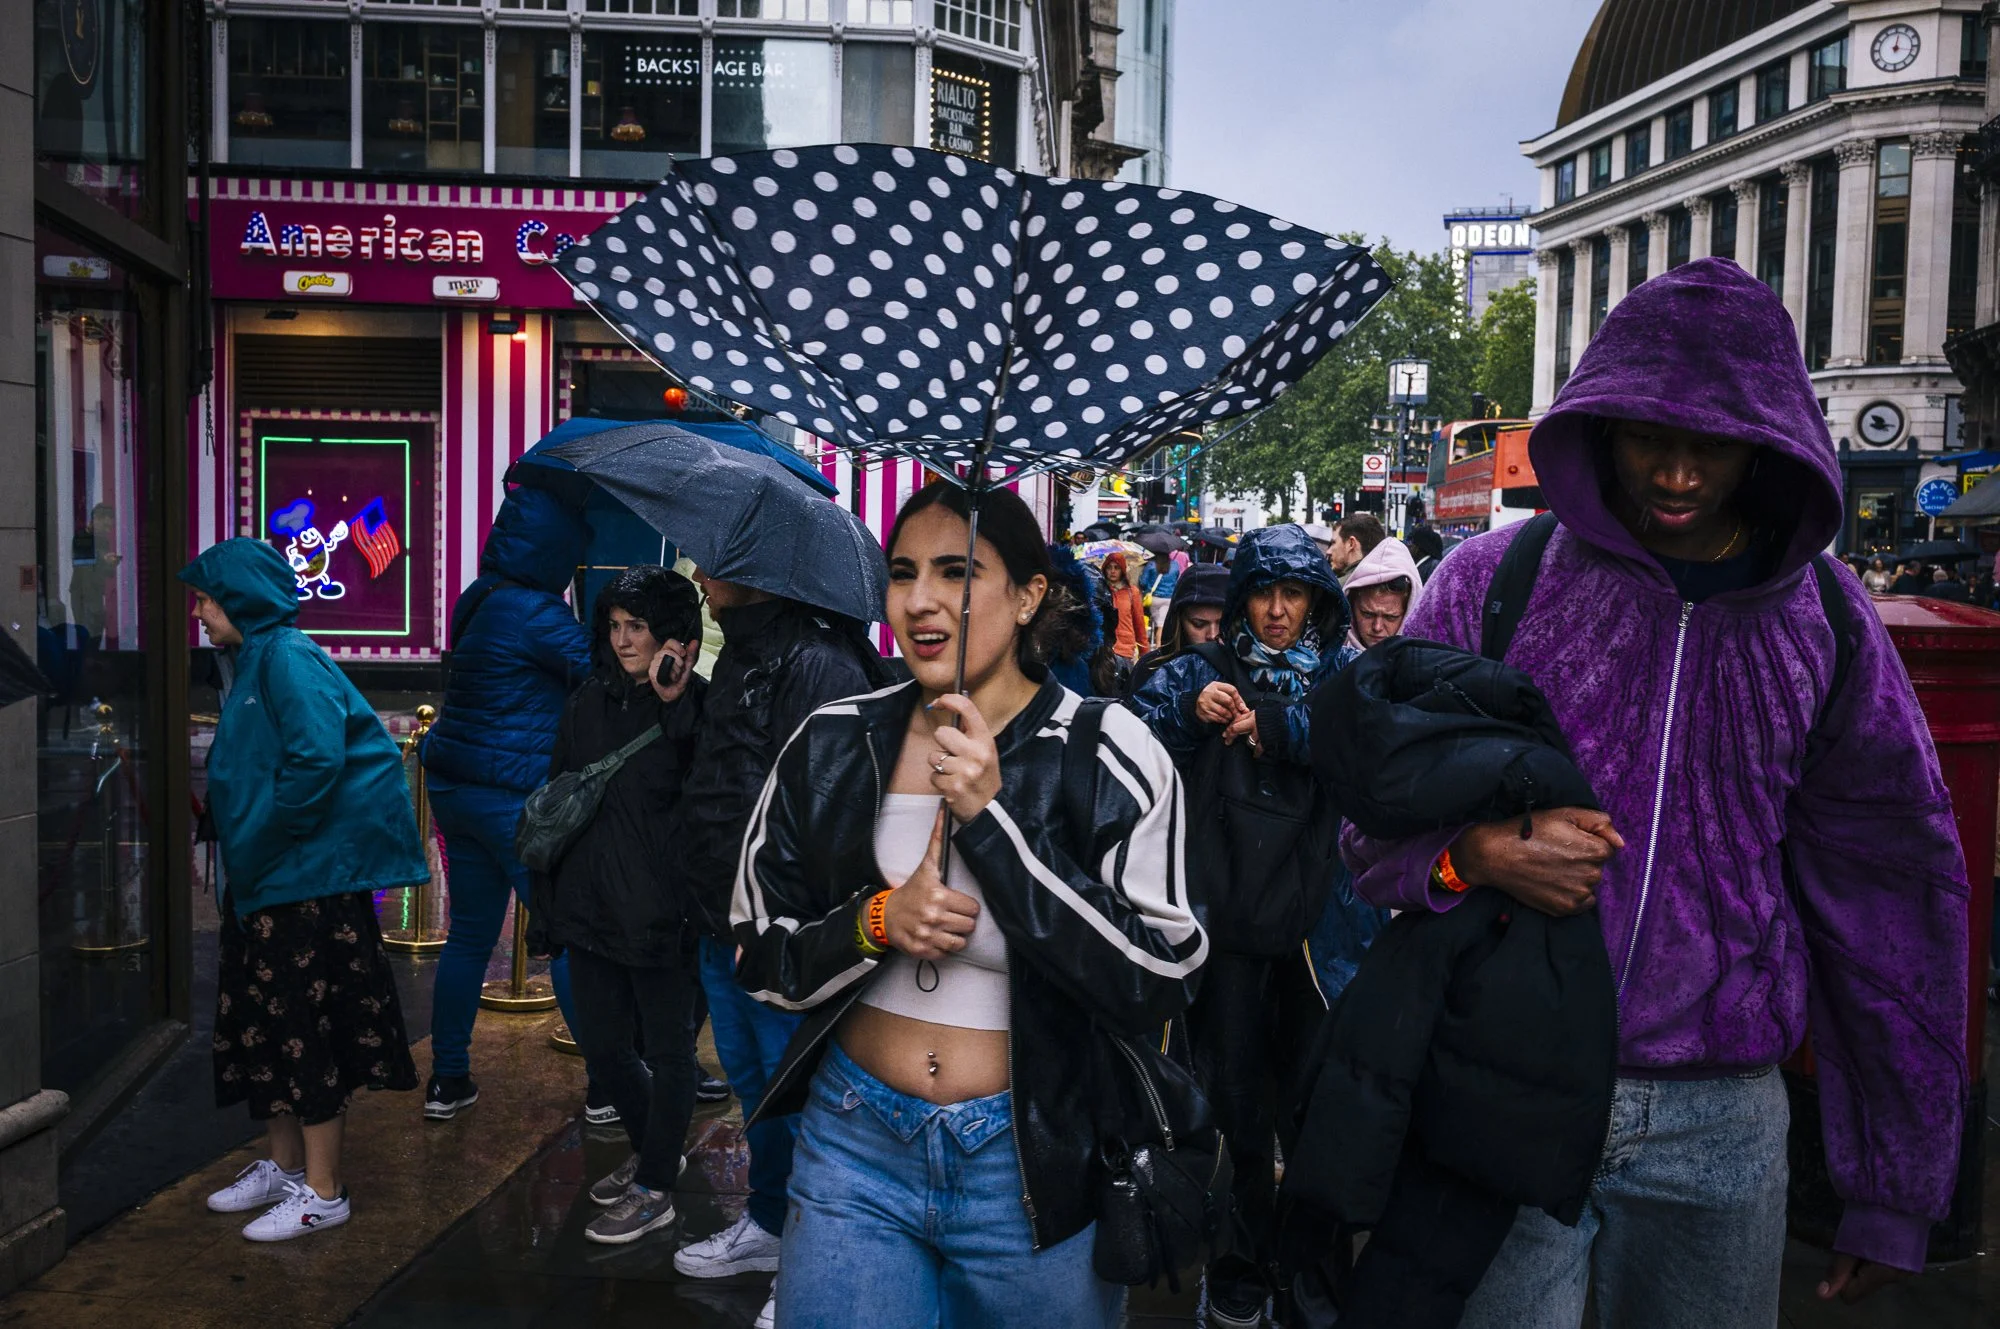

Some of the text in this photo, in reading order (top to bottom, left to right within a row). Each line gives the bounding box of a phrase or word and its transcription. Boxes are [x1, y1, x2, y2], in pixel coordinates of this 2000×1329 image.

[752, 61, 785, 77] BAR
[937, 81, 976, 110] RIALTO
[937, 105, 975, 126] BACKSTAGE
[949, 121, 963, 137] BAR
[948, 135, 973, 153] CASINO
[240, 211, 589, 265] American Ca
[1451, 223, 1530, 248] ODEON
[1919, 482, 1956, 504] CHANGE
[870, 895, 886, 940] DIRK
